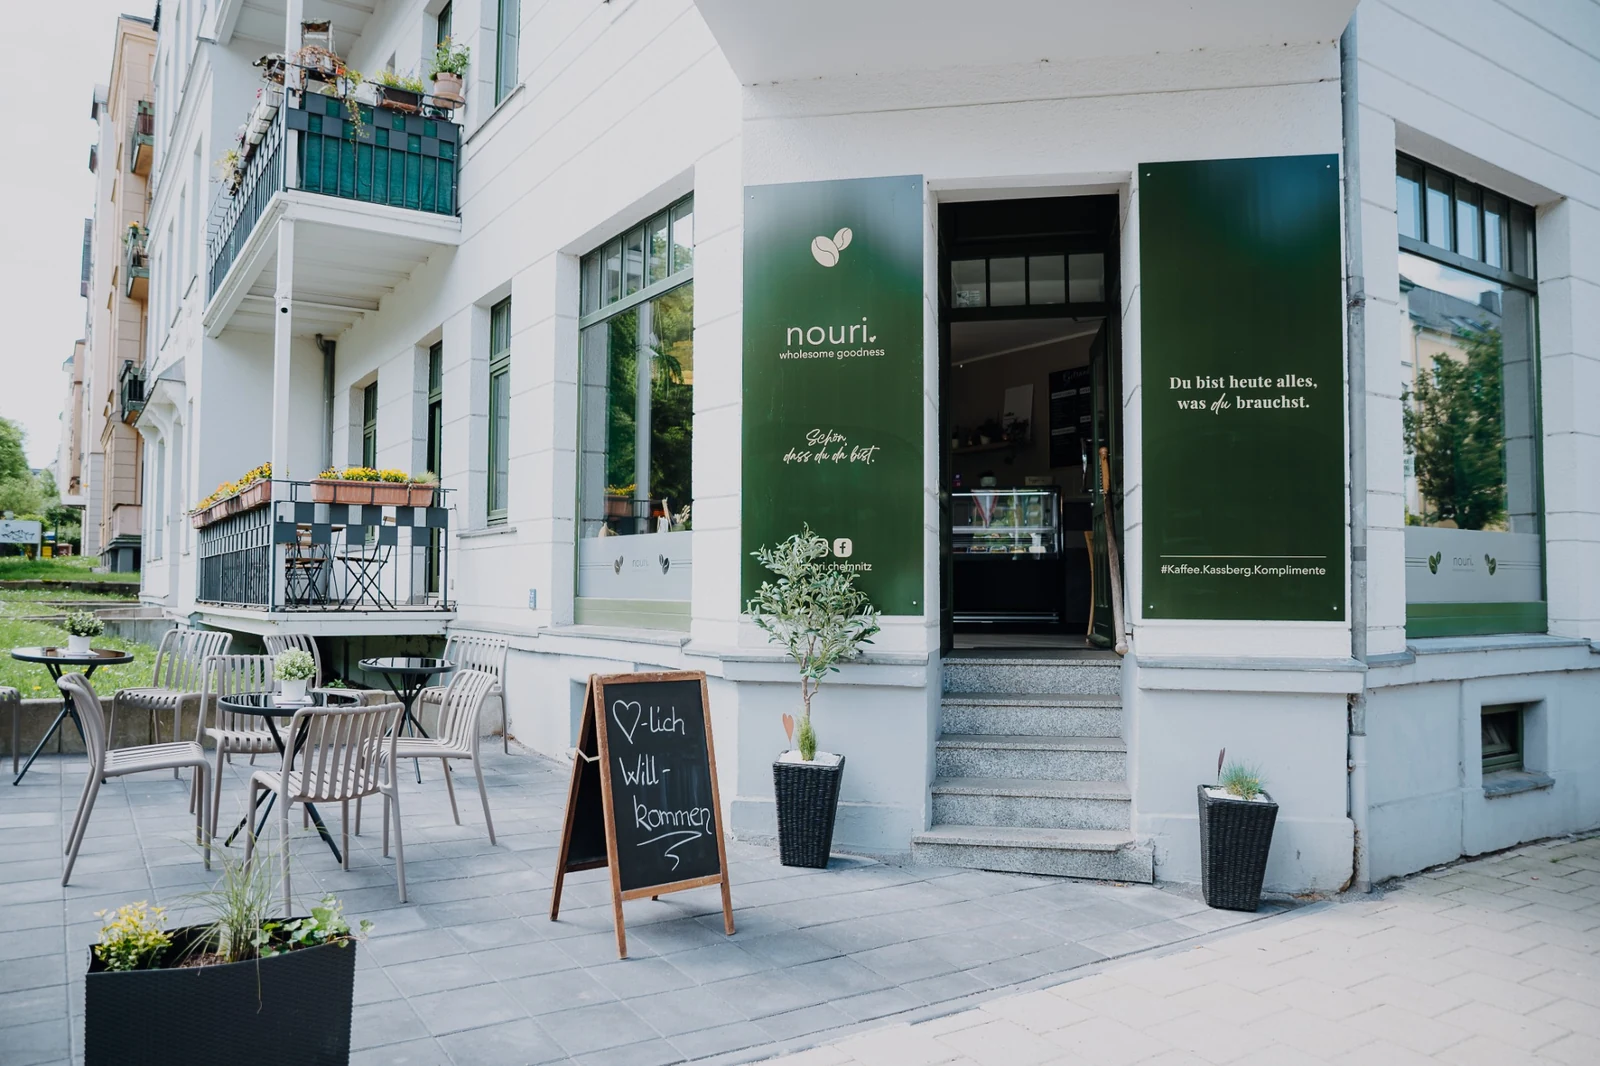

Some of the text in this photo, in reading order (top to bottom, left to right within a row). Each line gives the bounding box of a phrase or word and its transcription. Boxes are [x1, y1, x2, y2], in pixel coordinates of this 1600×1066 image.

[779, 347, 885, 360] wholesome goodness
[1169, 374, 1318, 389] Du bist heute alles,
[1177, 392, 1310, 415] was du brauchst.
[783, 444, 880, 465] dass du da bist.
[1161, 564, 1326, 578] #Kaffee.Kassberg.Komplimente
[632, 794, 713, 835] kommen
